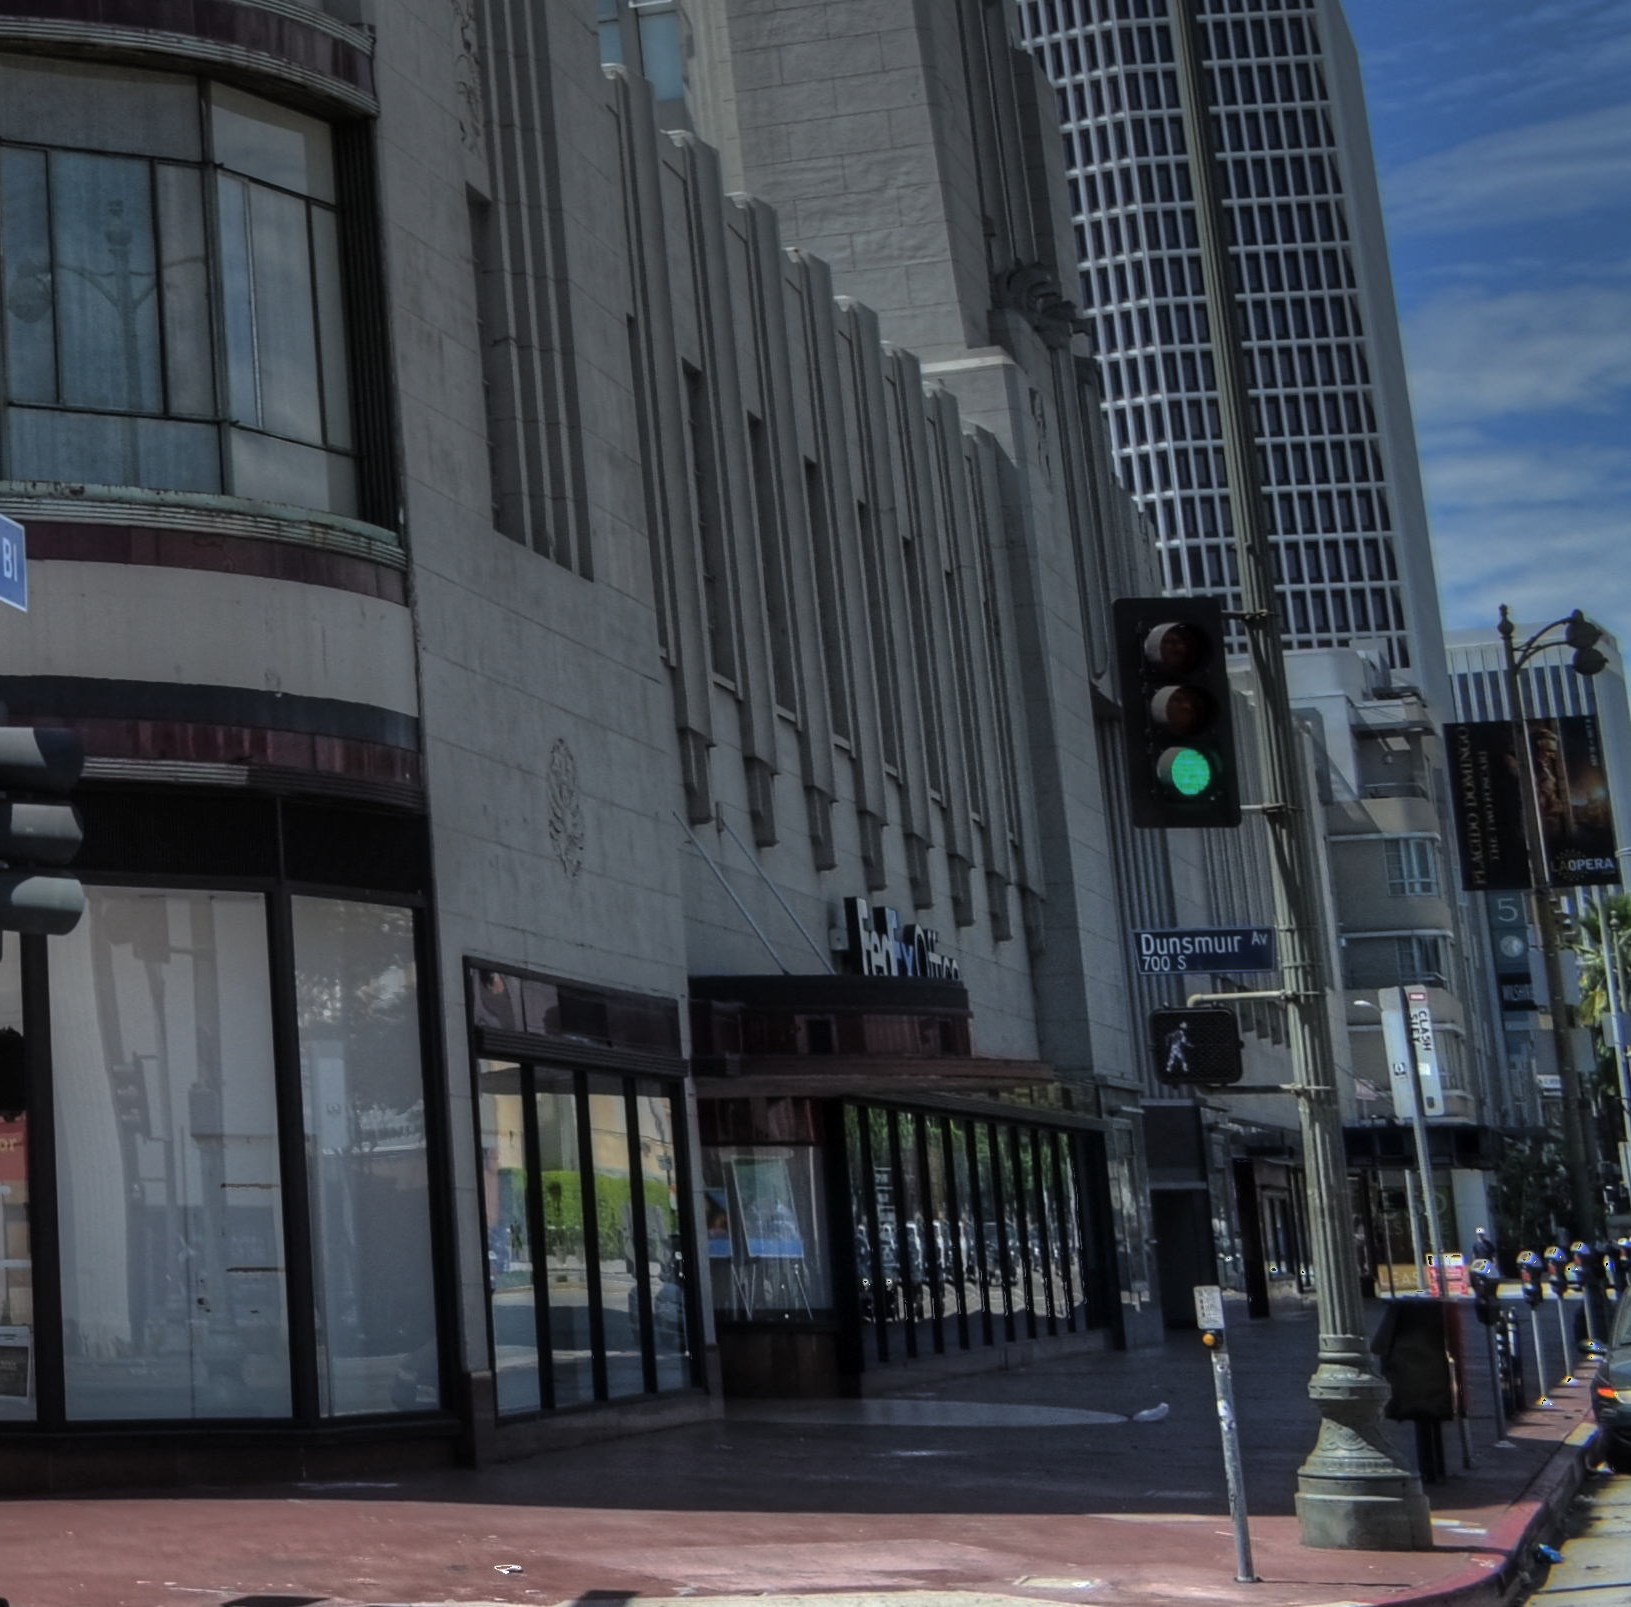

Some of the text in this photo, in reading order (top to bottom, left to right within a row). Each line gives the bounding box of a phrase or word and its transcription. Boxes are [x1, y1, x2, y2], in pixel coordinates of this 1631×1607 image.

[2, 537, 18, 583] Bl
[1456, 726, 1478, 807] DOMINGO
[1140, 931, 1268, 955] Dunsmuir Av
[1142, 955, 1187, 971] 700 S
